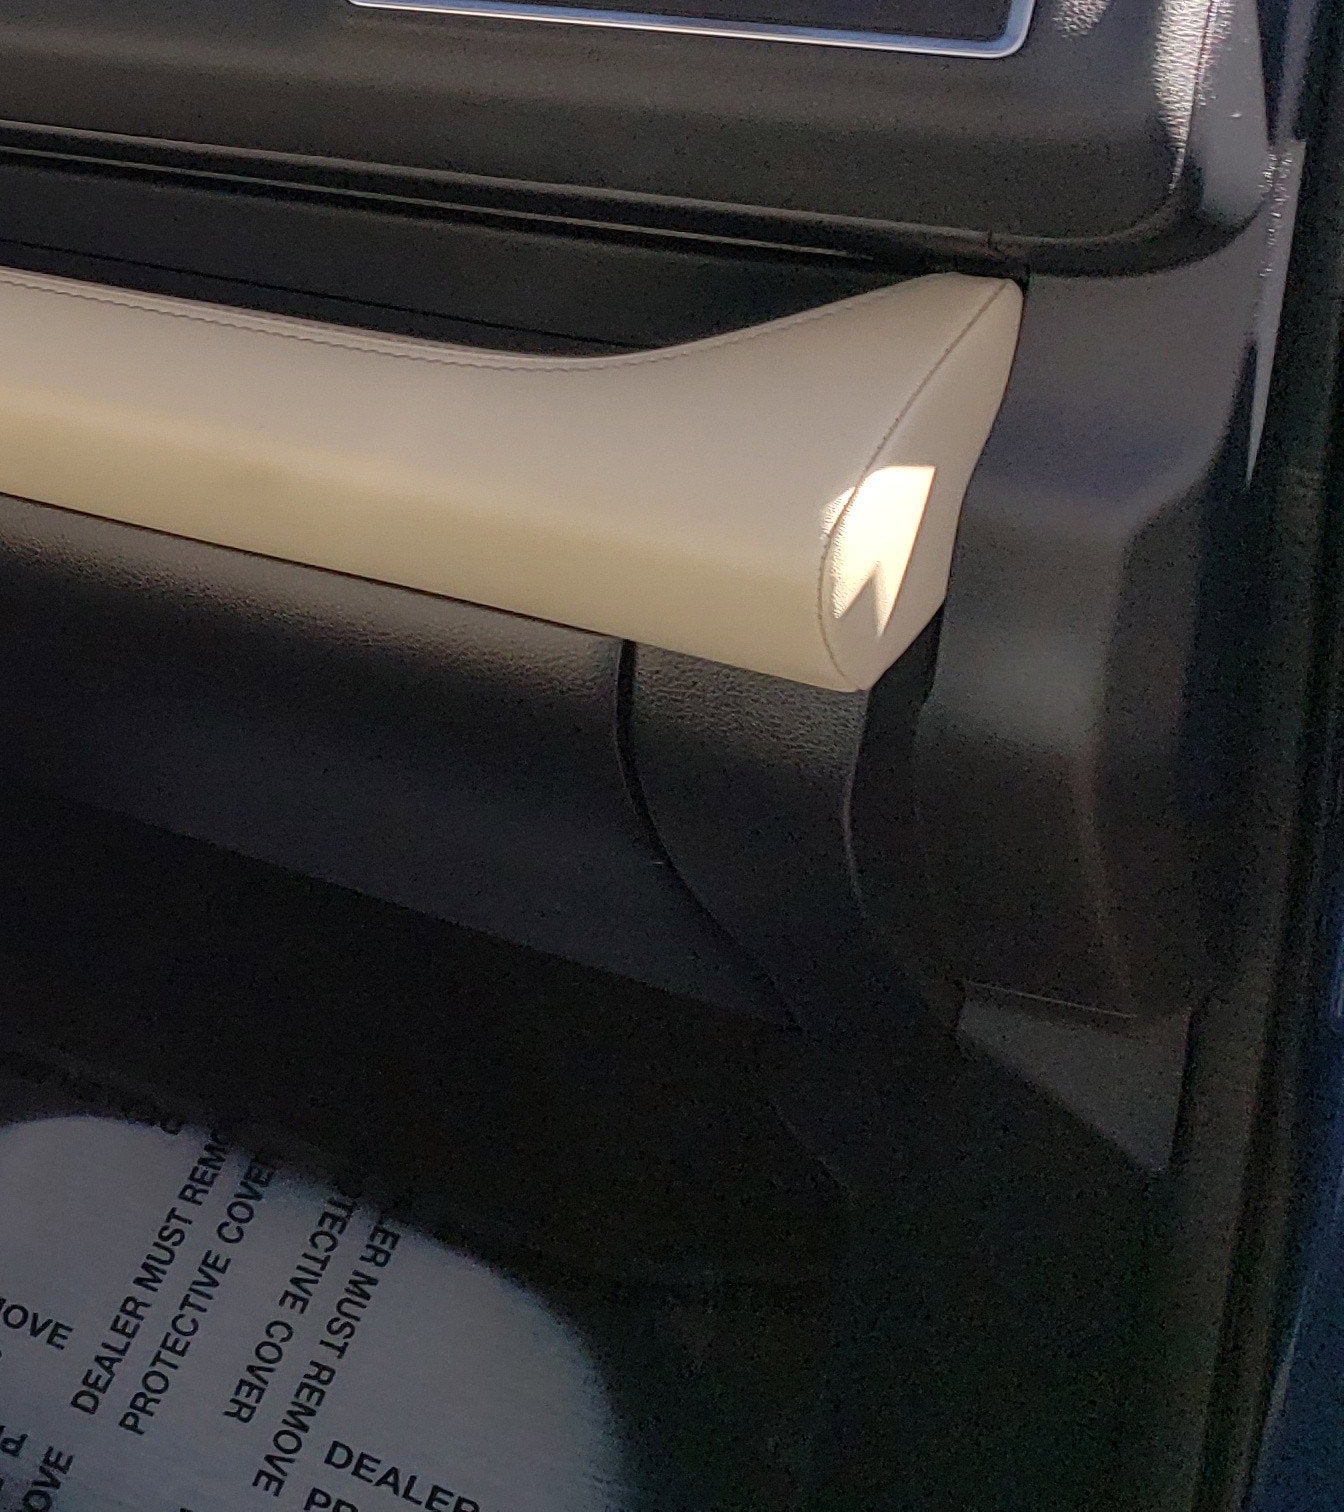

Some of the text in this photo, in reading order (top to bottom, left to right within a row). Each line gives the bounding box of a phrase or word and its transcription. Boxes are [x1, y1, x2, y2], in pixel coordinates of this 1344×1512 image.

[69, 1293, 152, 1415] DEALER
[132, 1206, 193, 1293] MUST
[118, 1249, 232, 1436] PROTECTIVE
[222, 1320, 295, 1425] COVER
[320, 1270, 379, 1361] MUST
[251, 1360, 336, 1497] REMOVE
